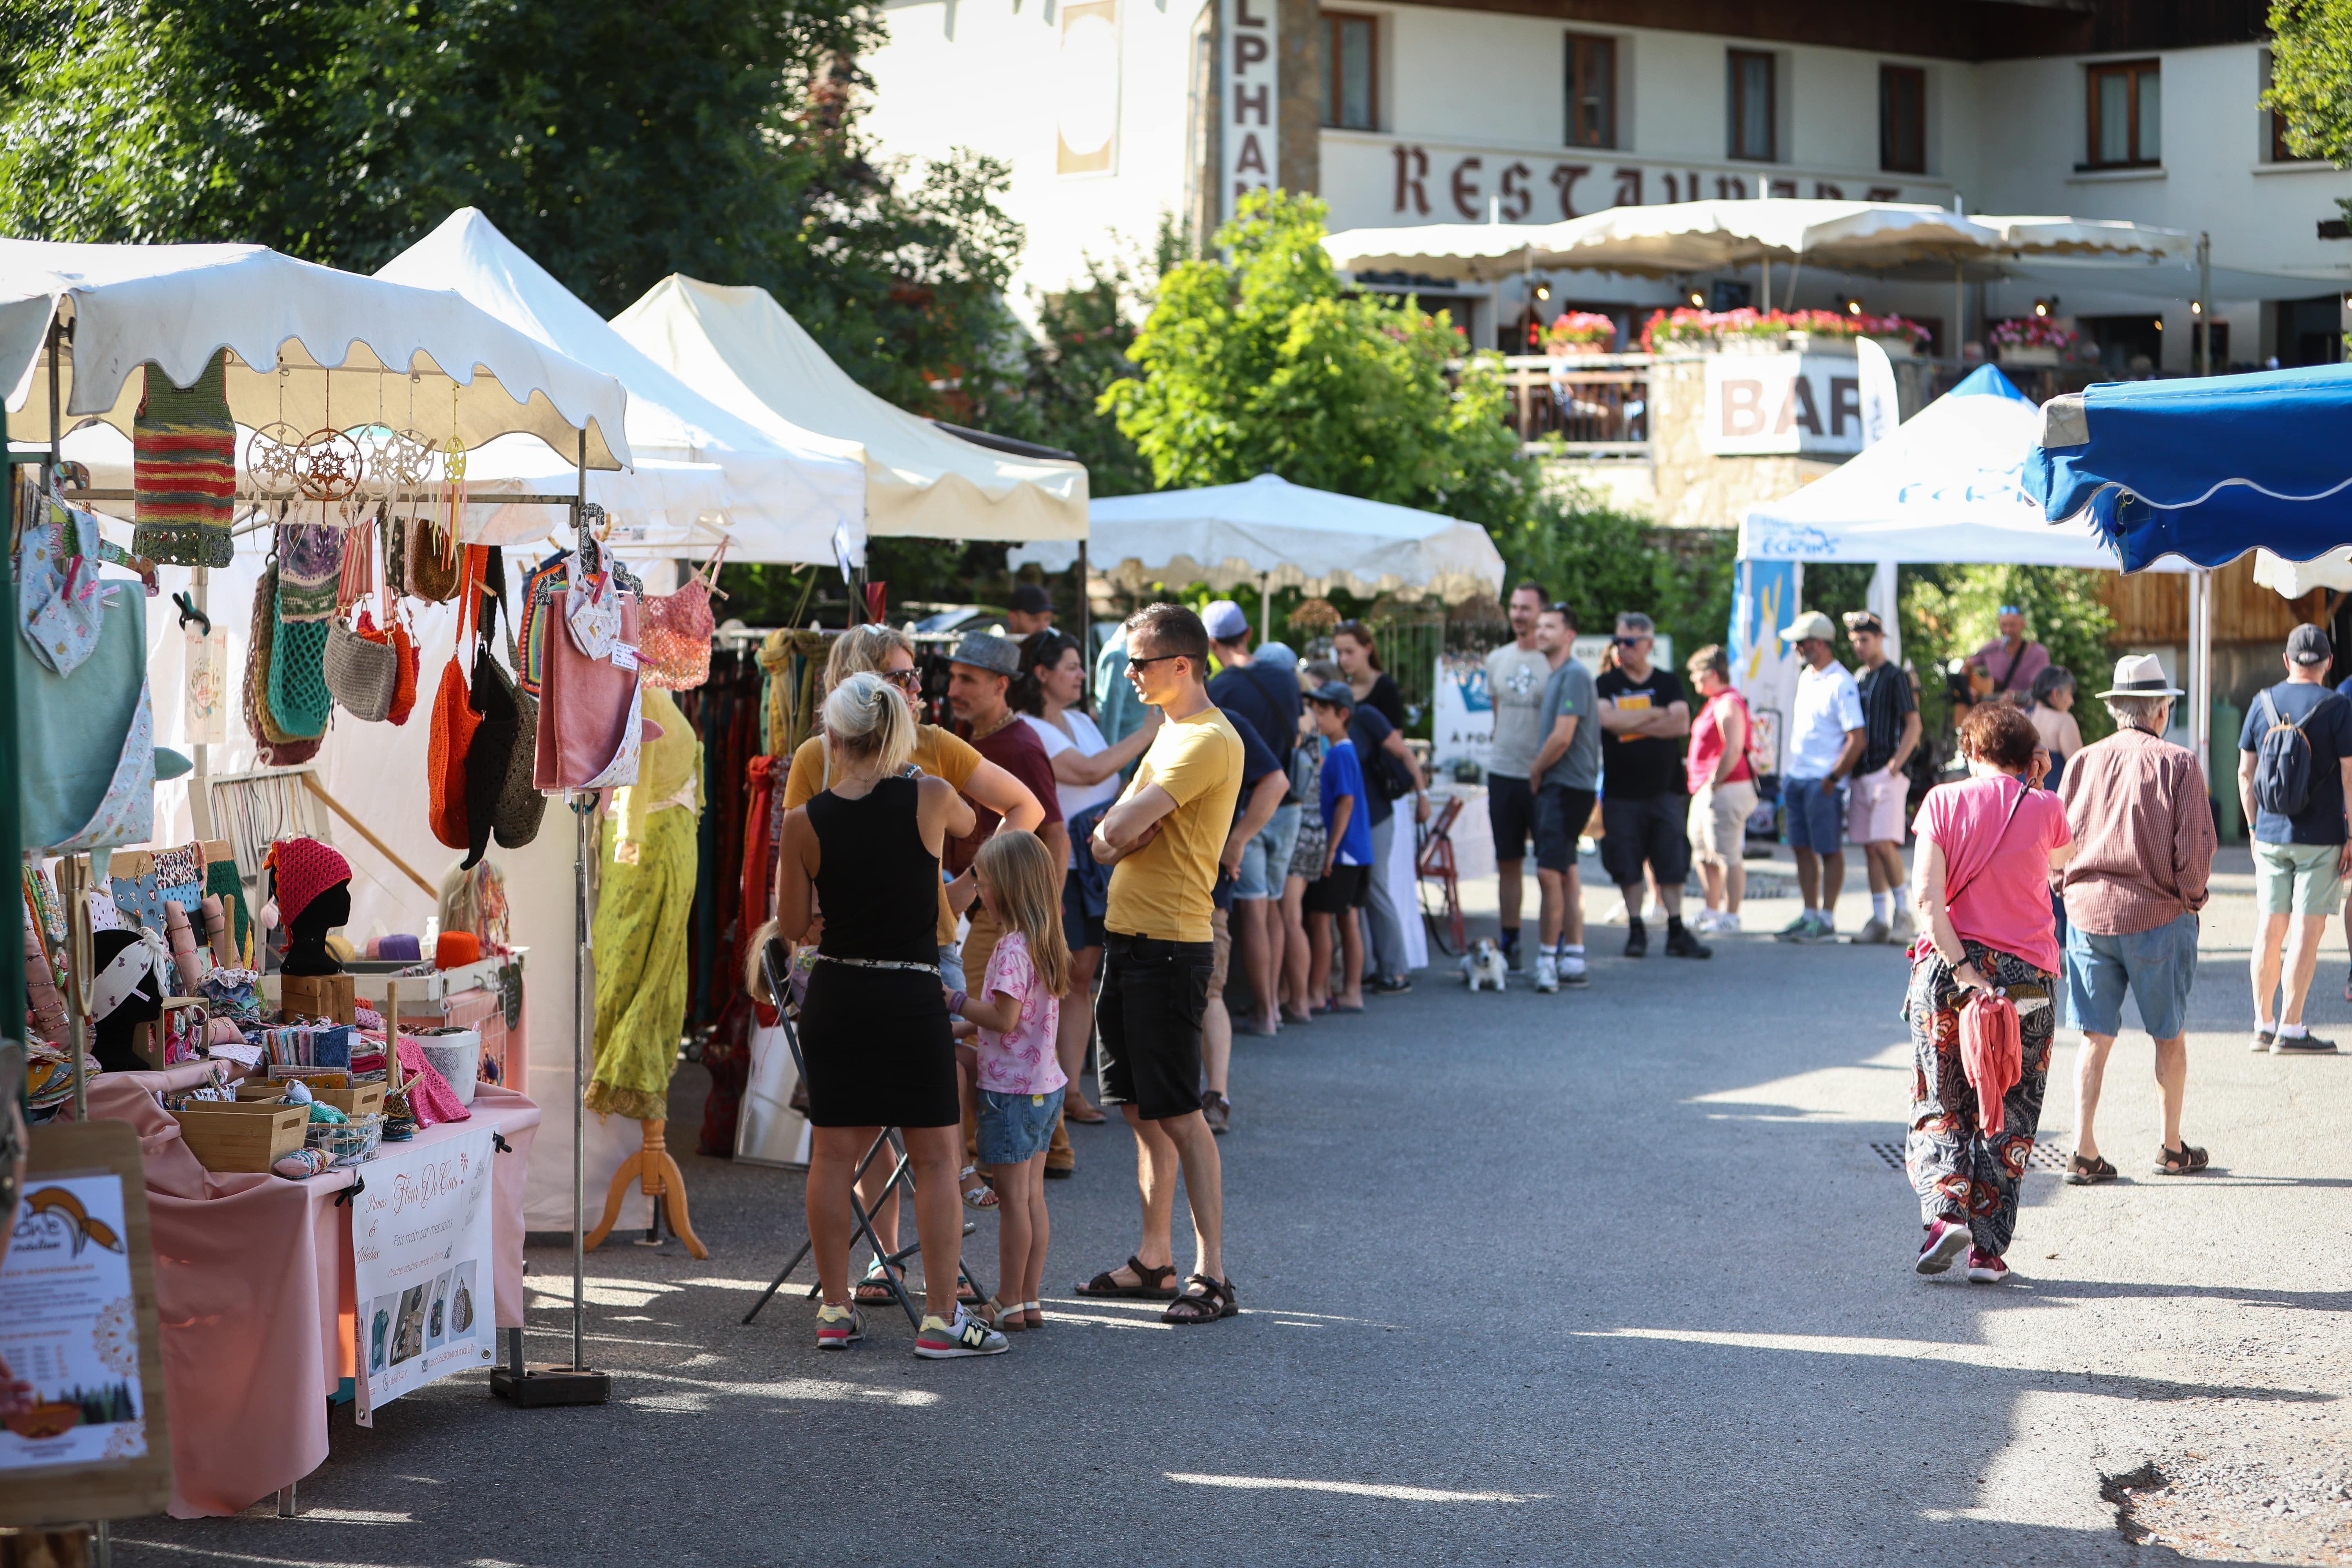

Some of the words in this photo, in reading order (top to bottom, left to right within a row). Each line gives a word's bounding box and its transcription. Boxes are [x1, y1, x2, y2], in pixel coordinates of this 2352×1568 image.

[1234, 0, 1271, 220] LPHA
[393, 1172, 418, 1216] Fleur
[419, 1163, 437, 1209] De
[439, 1160, 458, 1195] Coco
[366, 1193, 387, 1213] Plumes
[393, 1234, 404, 1247] Fait
[405, 1230, 419, 1243] main
[419, 1227, 430, 1243] par
[430, 1223, 440, 1236] mes
[441, 1218, 453, 1232] soins
[388, 1266, 404, 1278] Crochet
[404, 1261, 419, 1272] couture
[962, 1325, 983, 1346] N
